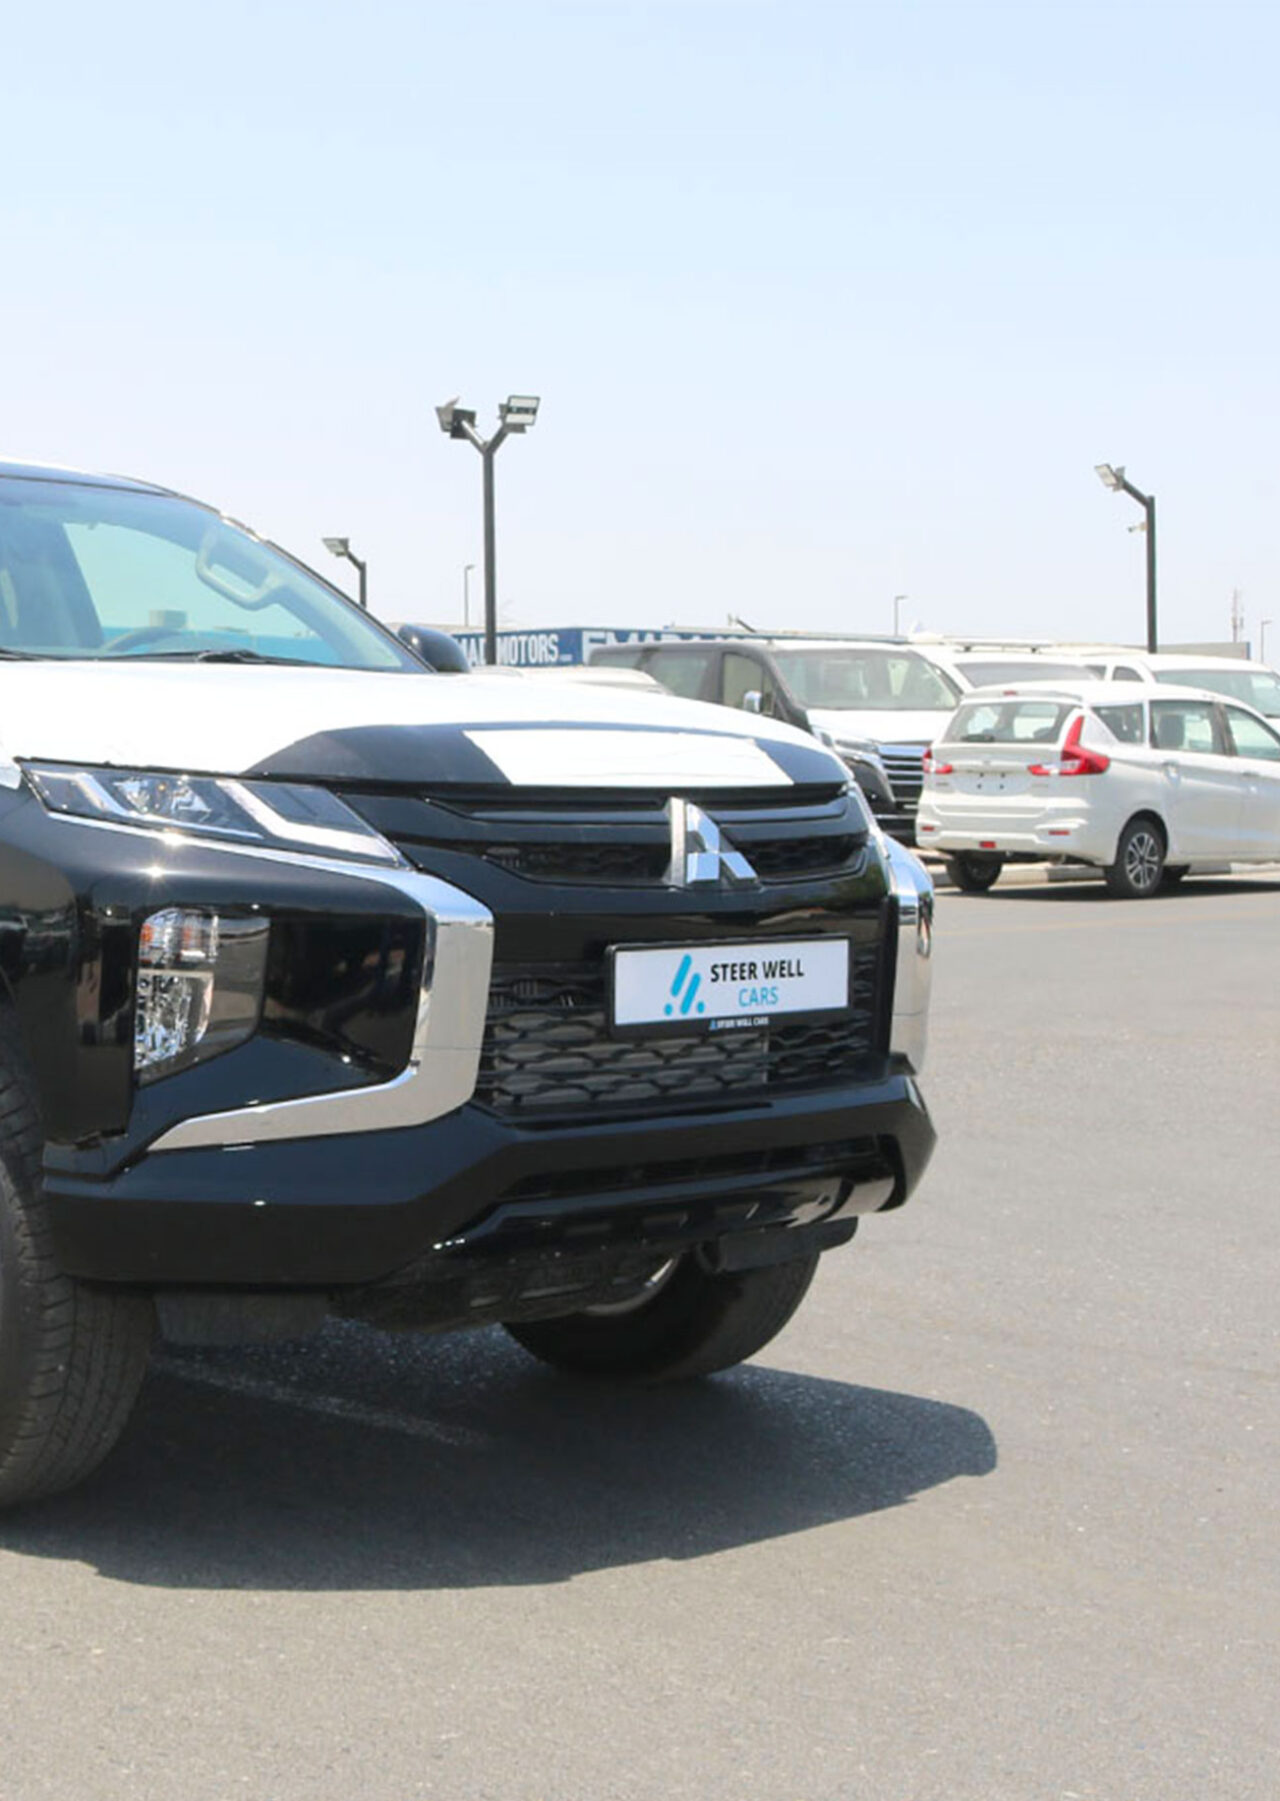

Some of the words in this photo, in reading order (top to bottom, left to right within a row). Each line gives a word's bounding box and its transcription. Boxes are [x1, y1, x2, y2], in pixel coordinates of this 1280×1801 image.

[497, 633, 559, 664] MOTORS
[710, 962, 757, 982] STEER
[763, 959, 804, 979] WELL
[738, 986, 778, 1007] CARS
